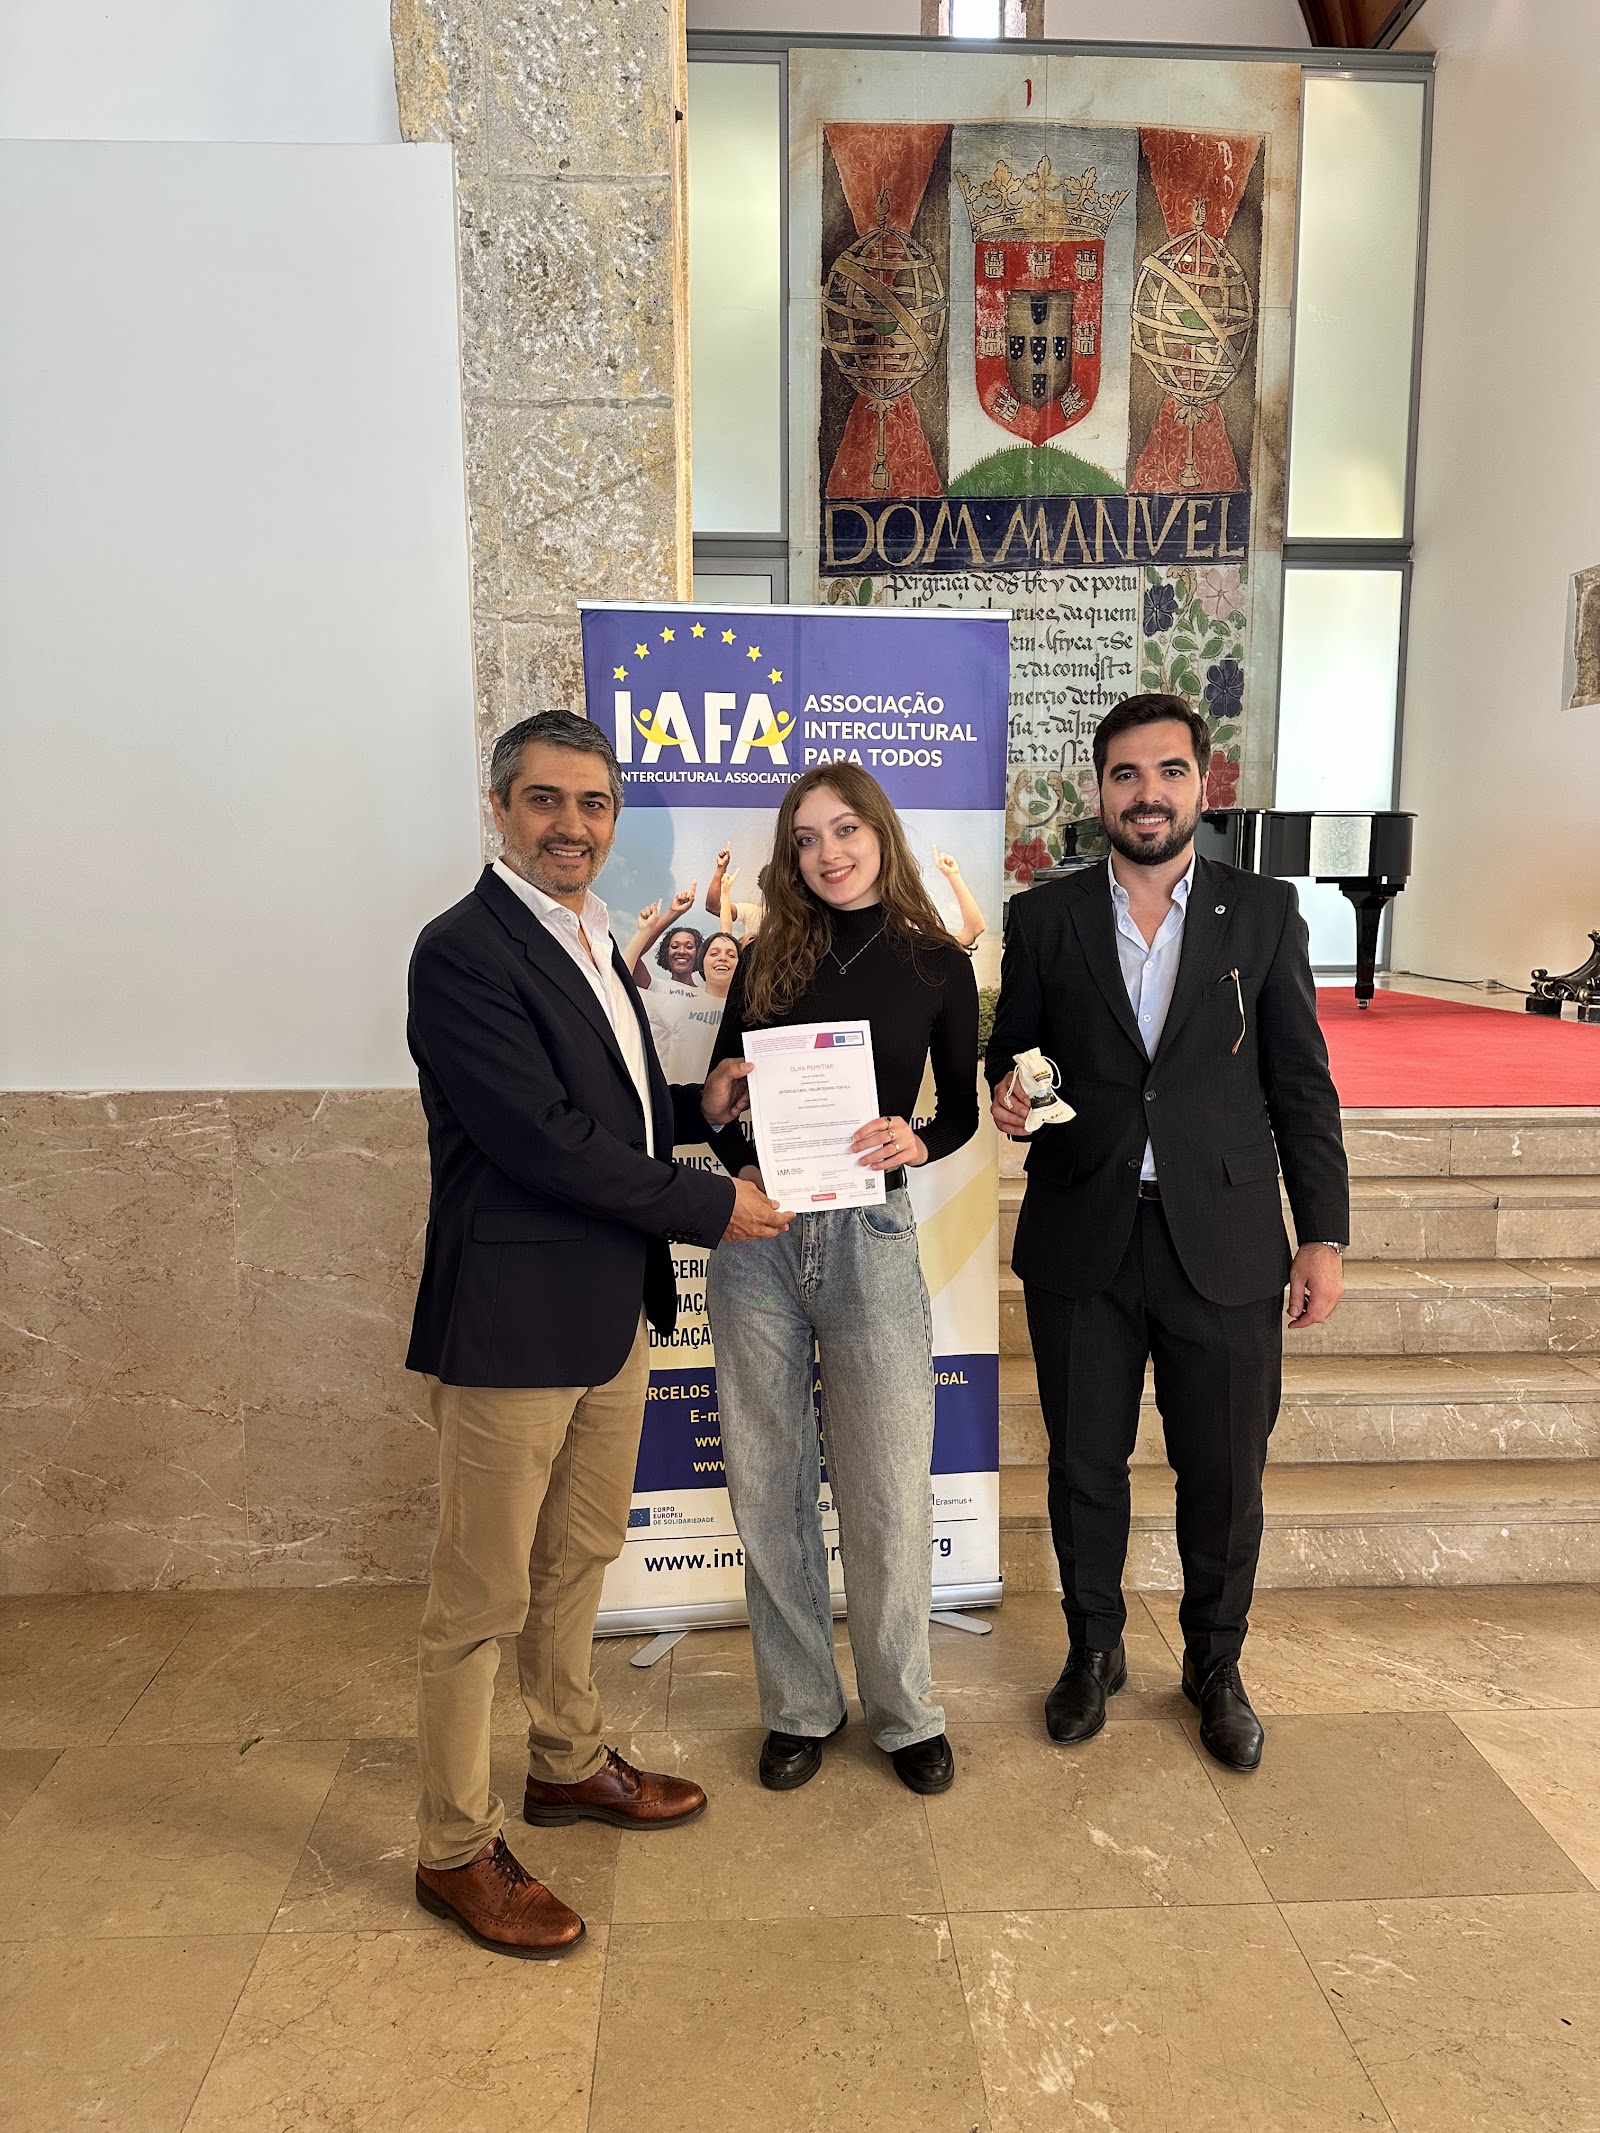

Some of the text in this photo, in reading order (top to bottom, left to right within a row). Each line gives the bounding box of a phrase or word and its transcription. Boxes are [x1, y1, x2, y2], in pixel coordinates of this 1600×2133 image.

[825, 501, 984, 568] DOM
[804, 691, 944, 719] ASSOCIAÇÃO
[614, 690, 791, 765] IAFA
[804, 720, 978, 742] INTERCULTURAL
[804, 748, 944, 768] PARA TODOS
[621, 771, 804, 784] NTERCULTURAL ASSOCIATIO
[935, 1497, 974, 1506] Erasmus+
